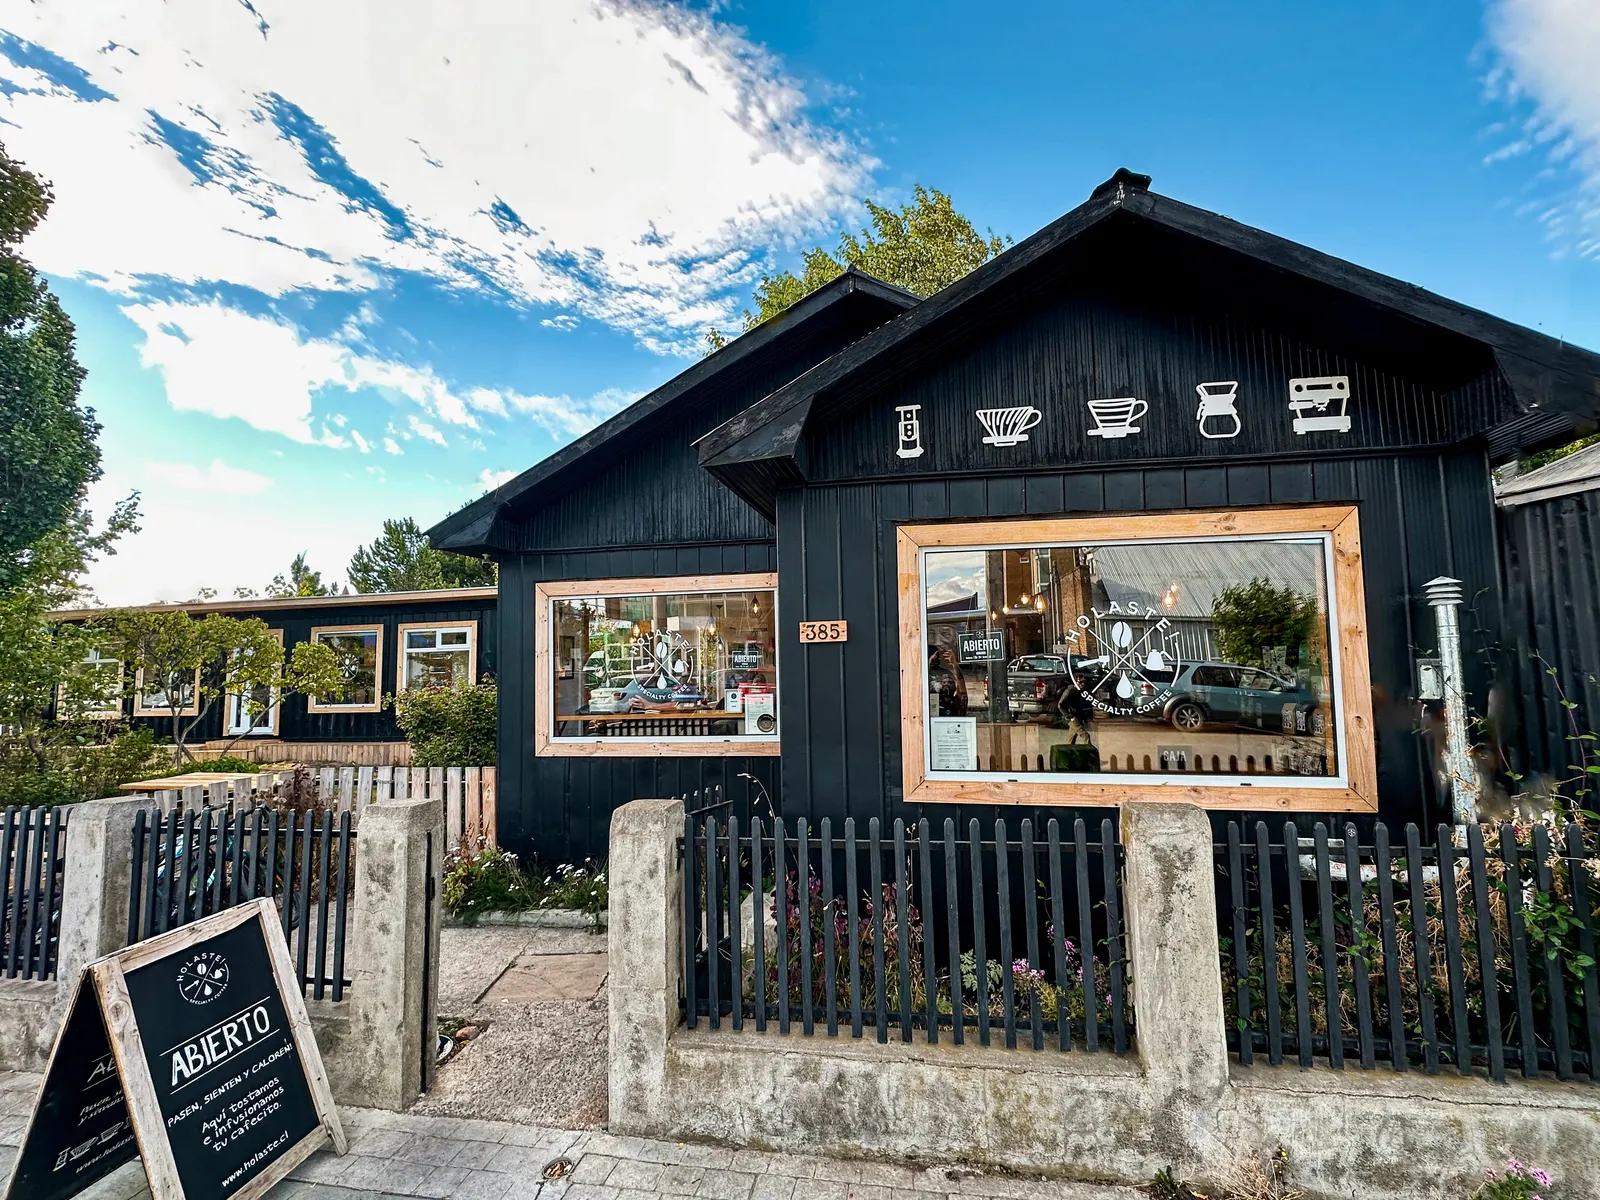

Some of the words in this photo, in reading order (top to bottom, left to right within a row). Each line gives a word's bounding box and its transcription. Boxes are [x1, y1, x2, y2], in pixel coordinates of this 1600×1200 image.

[806, 624, 840, 640] 385
[1065, 601, 1180, 643] HOLASTE!
[734, 655, 757, 663] ABIERTO
[963, 638, 1000, 652] ABIERTO
[637, 684, 666, 700] SPECIALTY
[1081, 690, 1133, 715] SPECIALTY
[1136, 689, 1173, 713] COFFEE
[176, 953, 226, 982] HOLASTE!
[171, 1005, 270, 1087] ABIERTO
[167, 1102, 203, 1128] PASEN,
[204, 1075, 242, 1104] SIENTEN
[252, 1043, 293, 1074] CALOREN!
[202, 1108, 227, 1133] Aquí
[229, 1077, 280, 1113] tostamos
[203, 1136, 212, 1145] e
[215, 1086, 285, 1138] infusionamos
[213, 1138, 228, 1151] tu
[230, 1102, 281, 1140] cafecito.
[221, 1129, 289, 1187] www.holaste.cl
